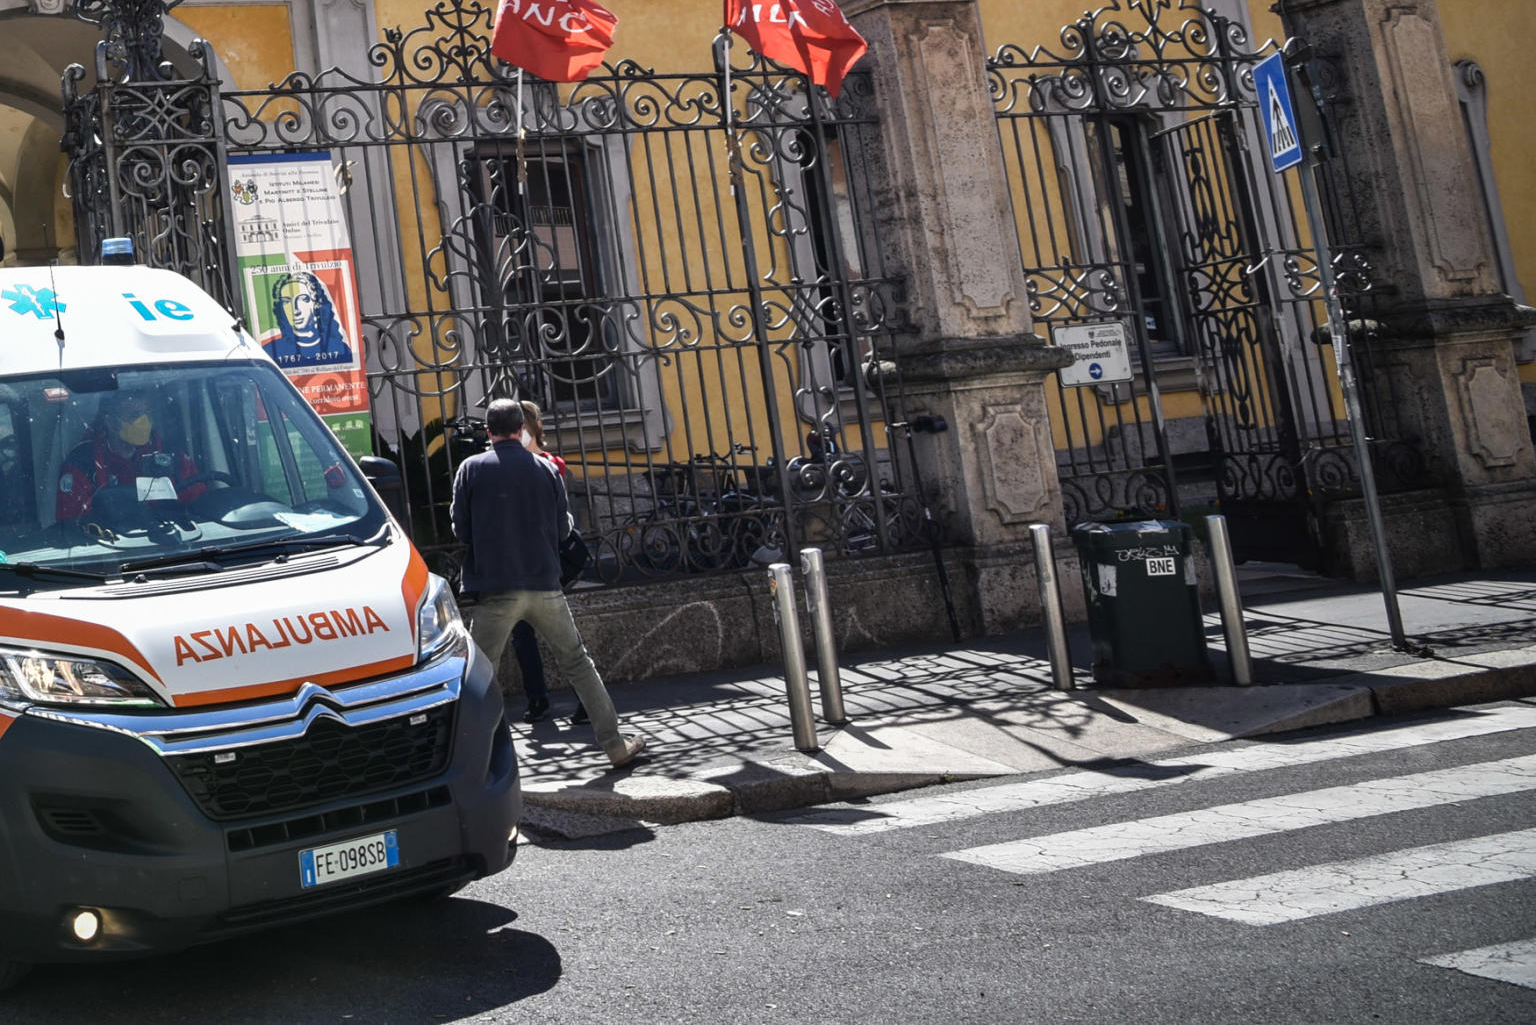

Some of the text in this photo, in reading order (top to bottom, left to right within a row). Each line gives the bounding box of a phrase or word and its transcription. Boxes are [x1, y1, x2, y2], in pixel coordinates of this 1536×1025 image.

[1090, 339, 1121, 348] Pedonale
[278, 355, 301, 363] 1767
[316, 351, 339, 360] 2017
[1074, 351, 1111, 360] Dipendenti
[312, 382, 364, 393] PERMANENTE
[1149, 559, 1173, 574] BNE
